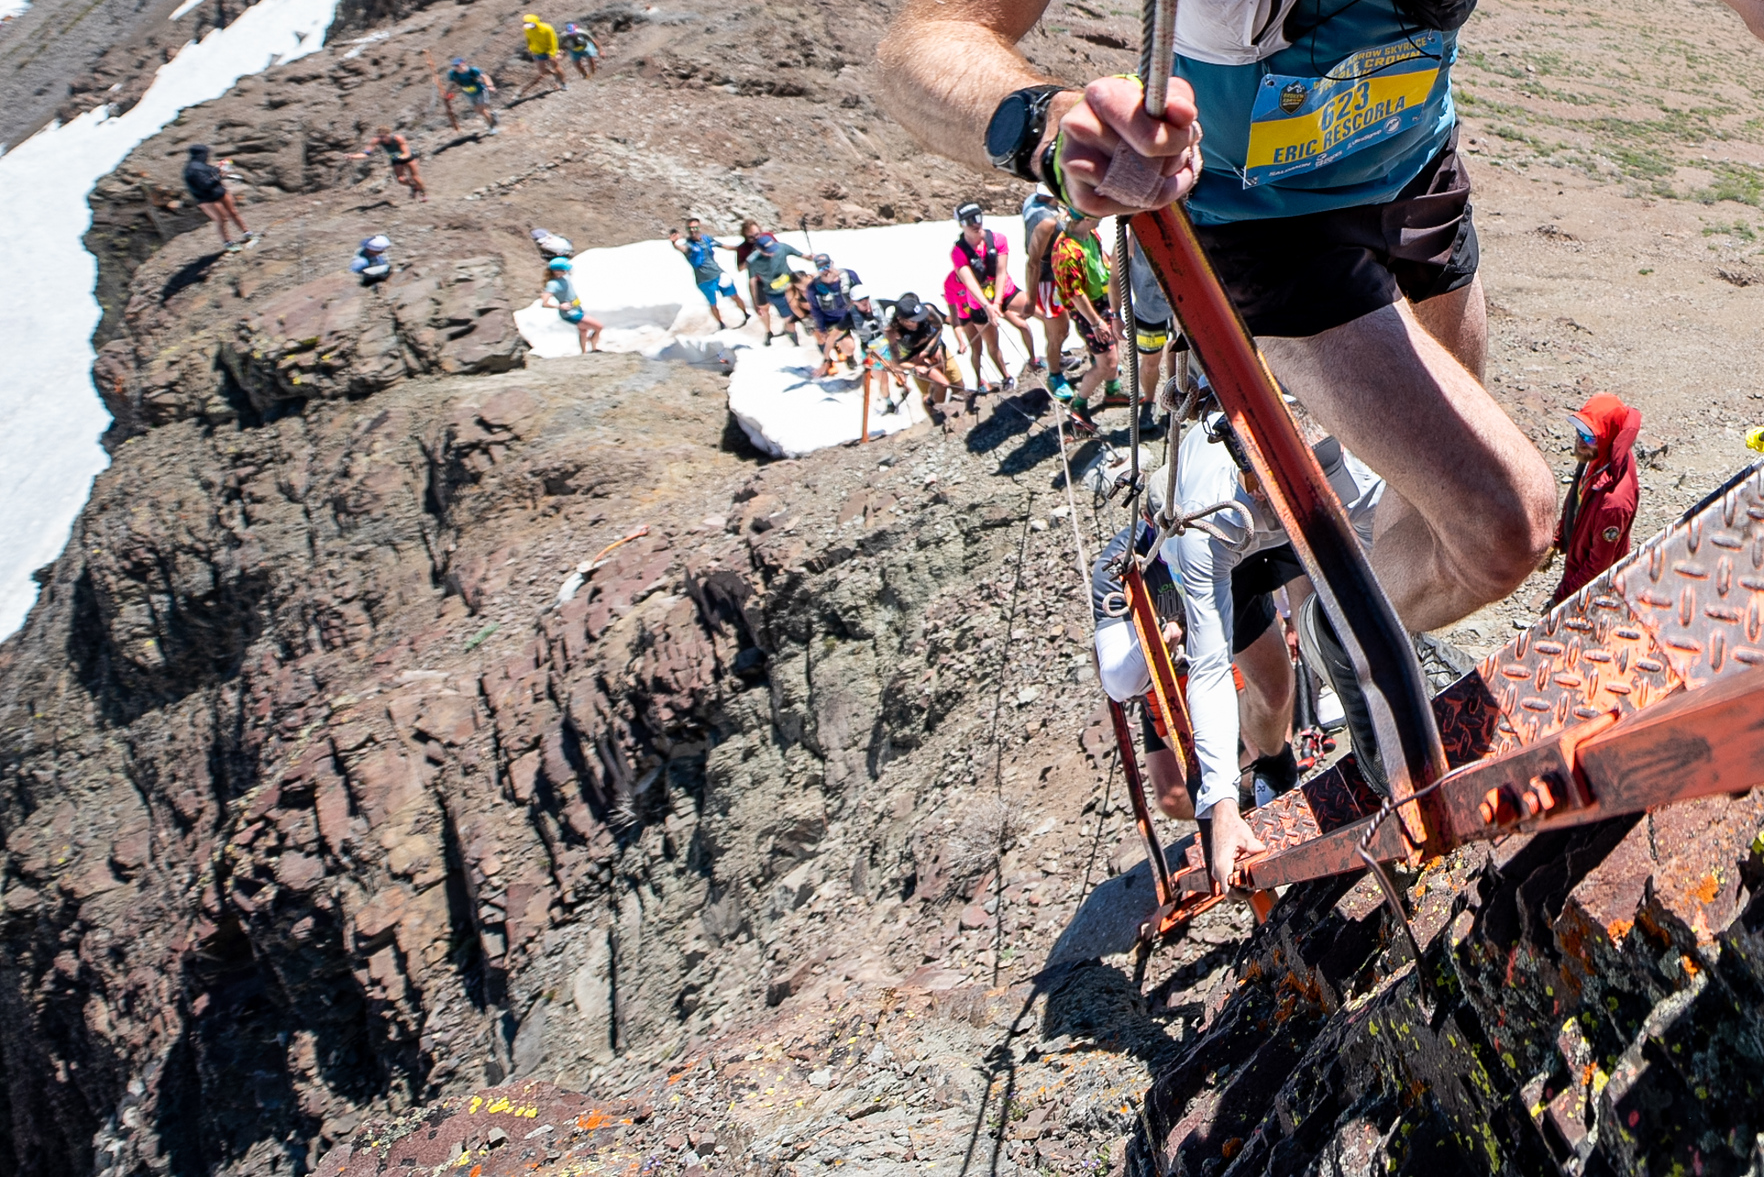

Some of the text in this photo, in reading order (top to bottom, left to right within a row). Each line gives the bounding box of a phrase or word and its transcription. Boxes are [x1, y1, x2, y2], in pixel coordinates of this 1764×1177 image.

[1347, 49, 1382, 66] ARROW
[1384, 36, 1427, 55] SKYRACE
[1364, 50, 1421, 68] CROWN
[1321, 81, 1370, 132] 623
[1273, 139, 1318, 164] ERIC
[1323, 95, 1405, 150] RESCORLA
